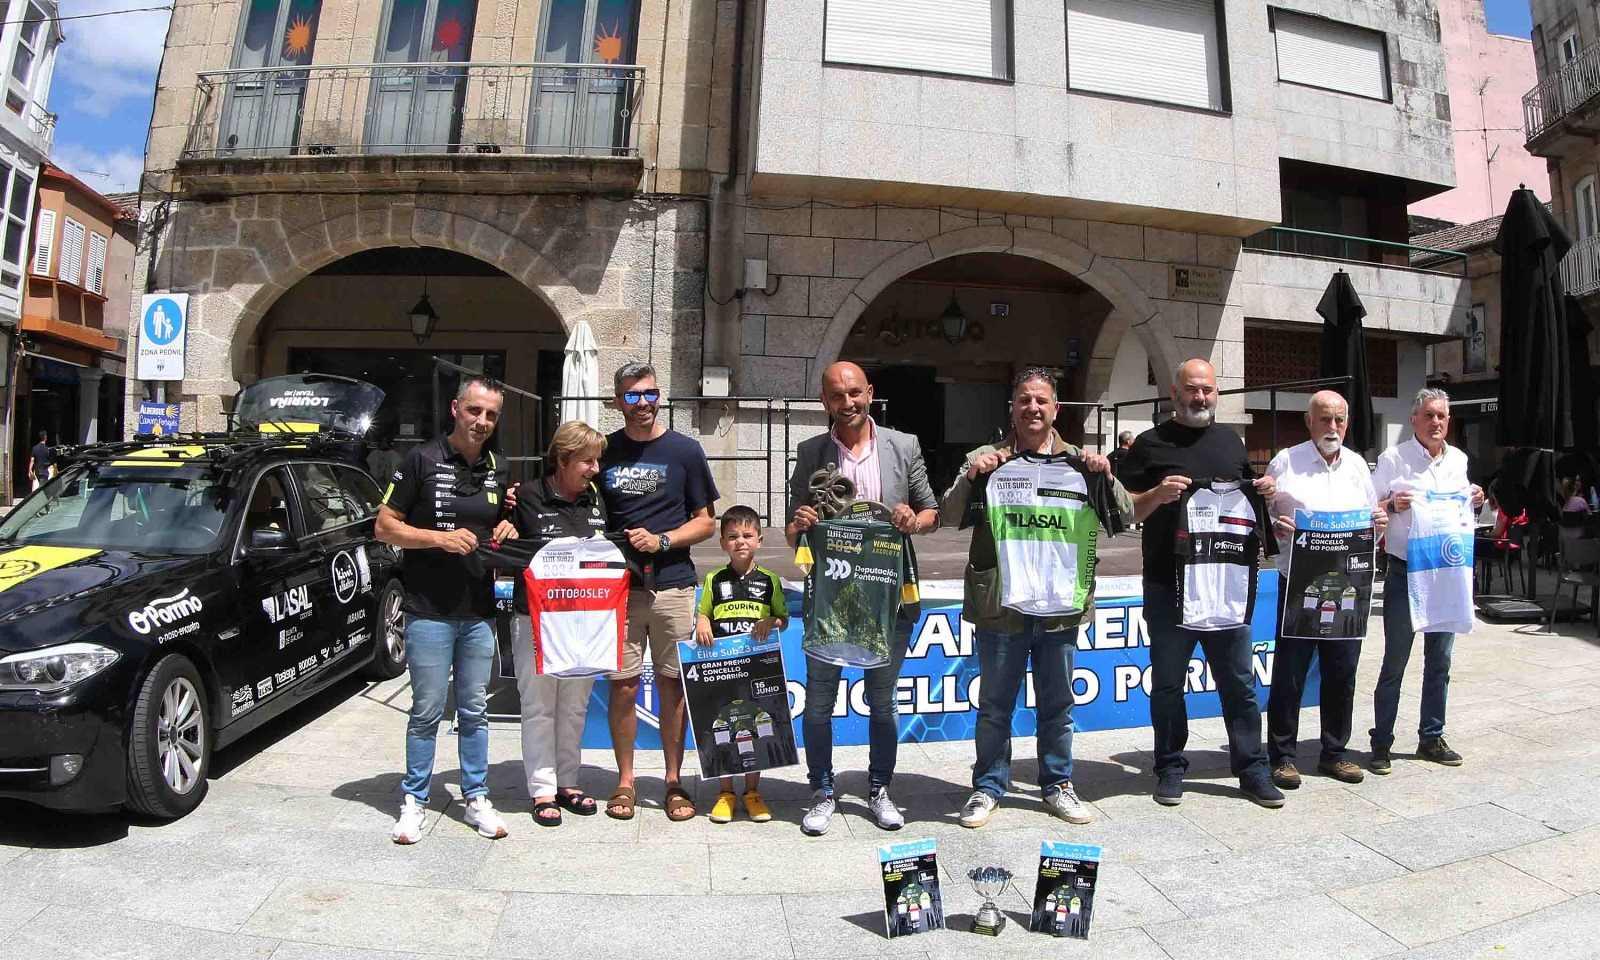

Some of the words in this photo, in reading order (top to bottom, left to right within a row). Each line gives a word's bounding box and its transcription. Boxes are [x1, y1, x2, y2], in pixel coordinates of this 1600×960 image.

[270, 397, 330, 408] LOURIÑA
[612, 478, 657, 492] JONES
[1019, 513, 1068, 530] LASAL
[826, 538, 863, 555] 2024
[1084, 530, 1098, 590] OTTOBOSLE
[855, 565, 898, 577] Deputación
[854, 571, 897, 585] Pontevedra
[547, 588, 611, 599] OTTOBOSLEY
[275, 584, 313, 622] LASAL
[724, 602, 760, 612] LOURIÑA
[720, 645, 751, 657] Sub23
[701, 660, 722, 669] GRAN
[723, 658, 751, 666] PREMIO
[703, 667, 741, 676] CONCELLO
[716, 672, 749, 681] PORRIÑO
[754, 681, 766, 689] 16
[755, 685, 780, 695] JUNIO
